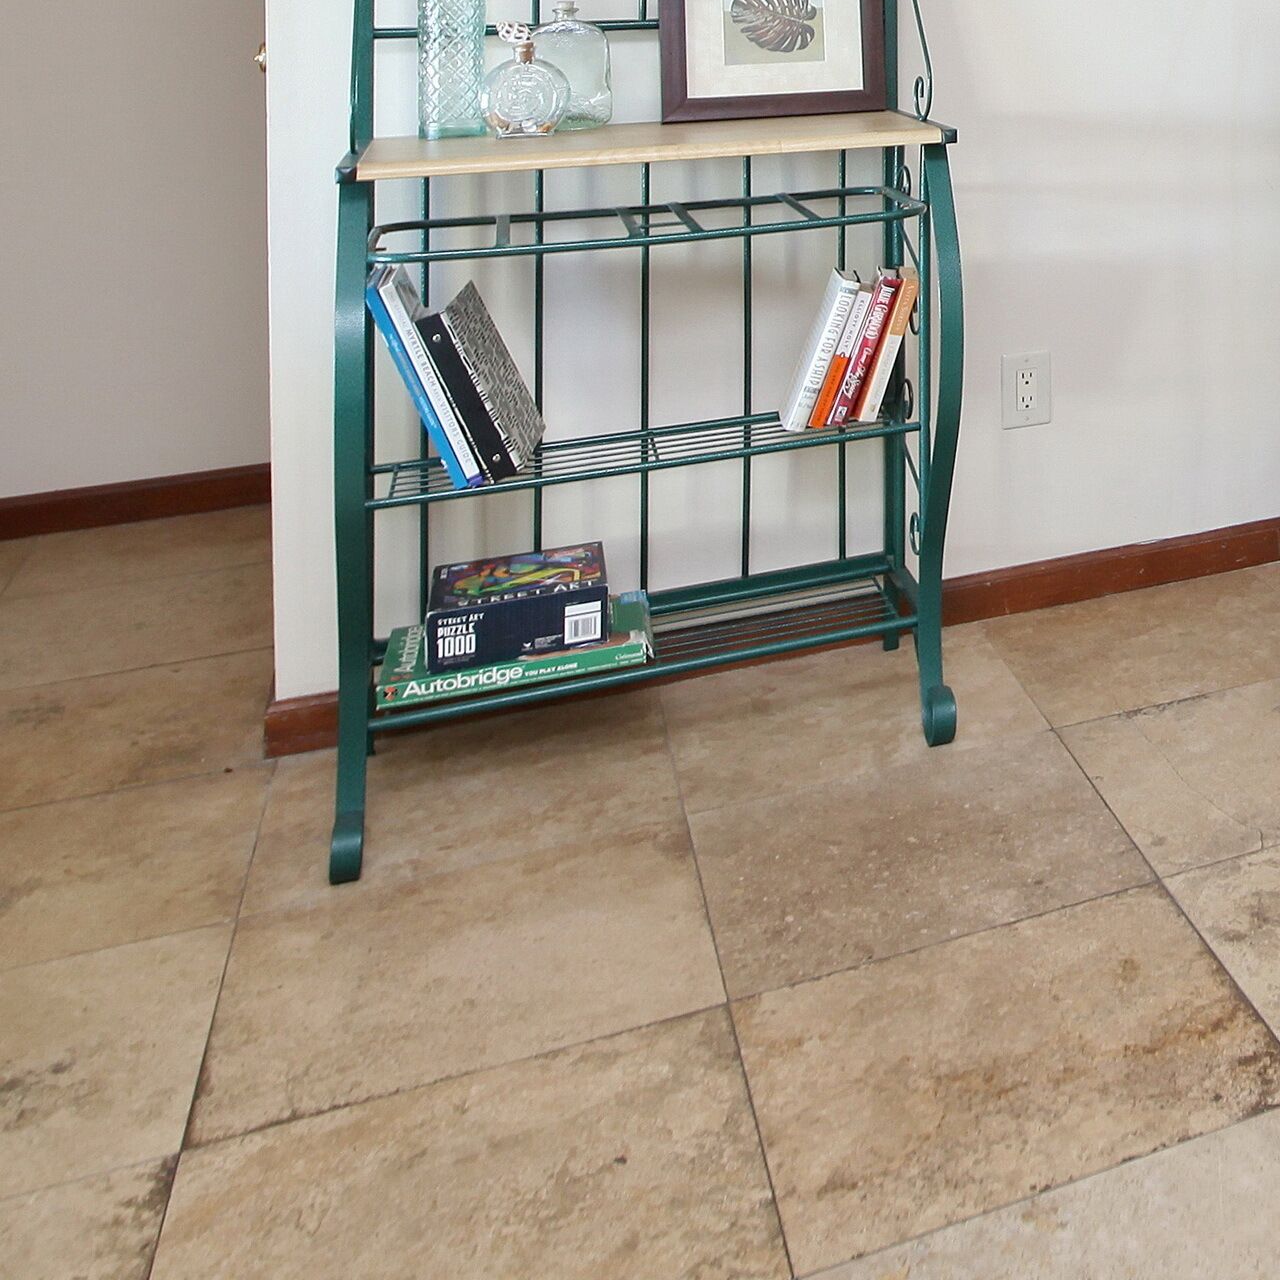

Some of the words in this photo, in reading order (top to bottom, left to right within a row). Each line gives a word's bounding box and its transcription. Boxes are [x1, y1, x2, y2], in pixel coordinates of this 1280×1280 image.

[827, 293, 851, 335] LOOKING
[851, 299, 864, 327] ELLIOTT
[820, 336, 835, 355] FOR
[816, 356, 828, 364] A
[808, 363, 826, 388] SHIP
[405, 327, 423, 359] MYRTLE
[420, 360, 436, 387] BEACH
[439, 401, 459, 437] VISITORS
[455, 438, 471, 463] GUIDE
[554, 579, 598, 592] ART
[437, 615, 468, 626] STREET
[468, 613, 485, 622] ART
[437, 622, 476, 638] PUZZLE
[436, 634, 476, 659] 1000
[402, 666, 523, 698] Autobridge
[539, 666, 557, 675] PLAY
